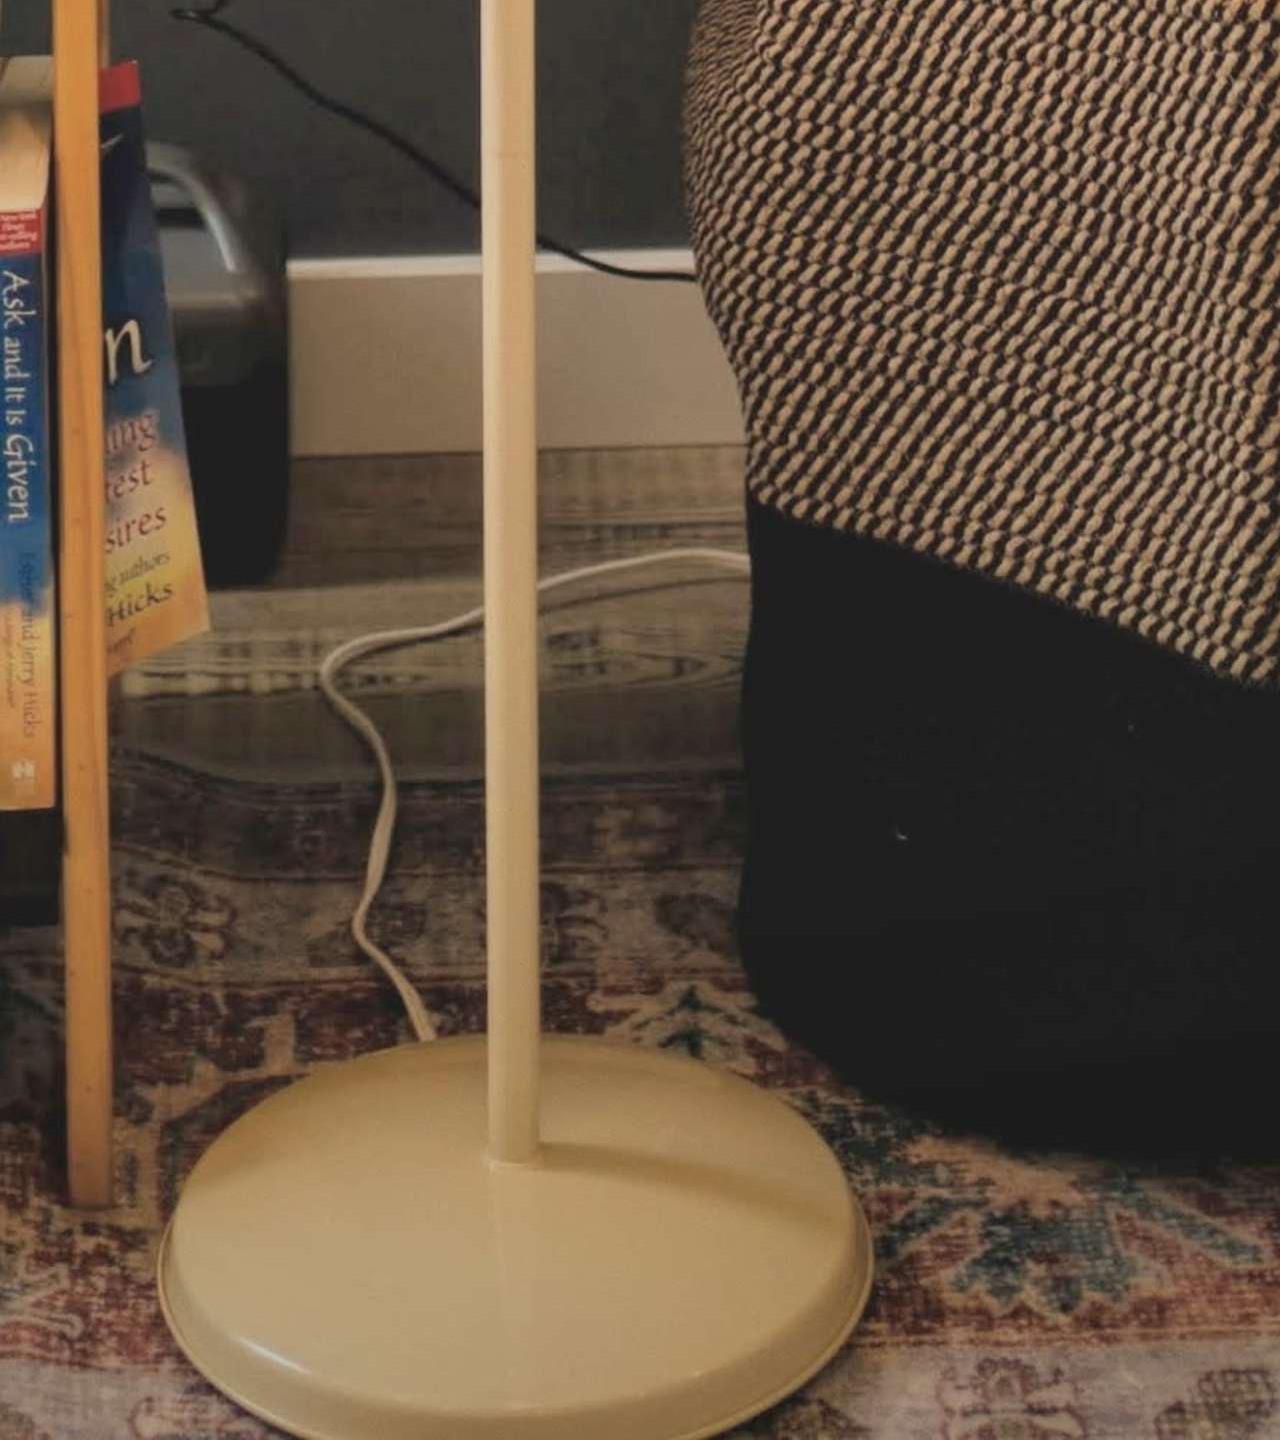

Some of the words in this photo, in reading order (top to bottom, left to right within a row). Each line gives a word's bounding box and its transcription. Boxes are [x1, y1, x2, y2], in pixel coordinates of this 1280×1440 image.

[2, 270, 35, 329] Ask
[4, 337, 30, 380] and
[4, 386, 26, 404] It
[6, 410, 26, 424] Is
[6, 434, 36, 523] Given
